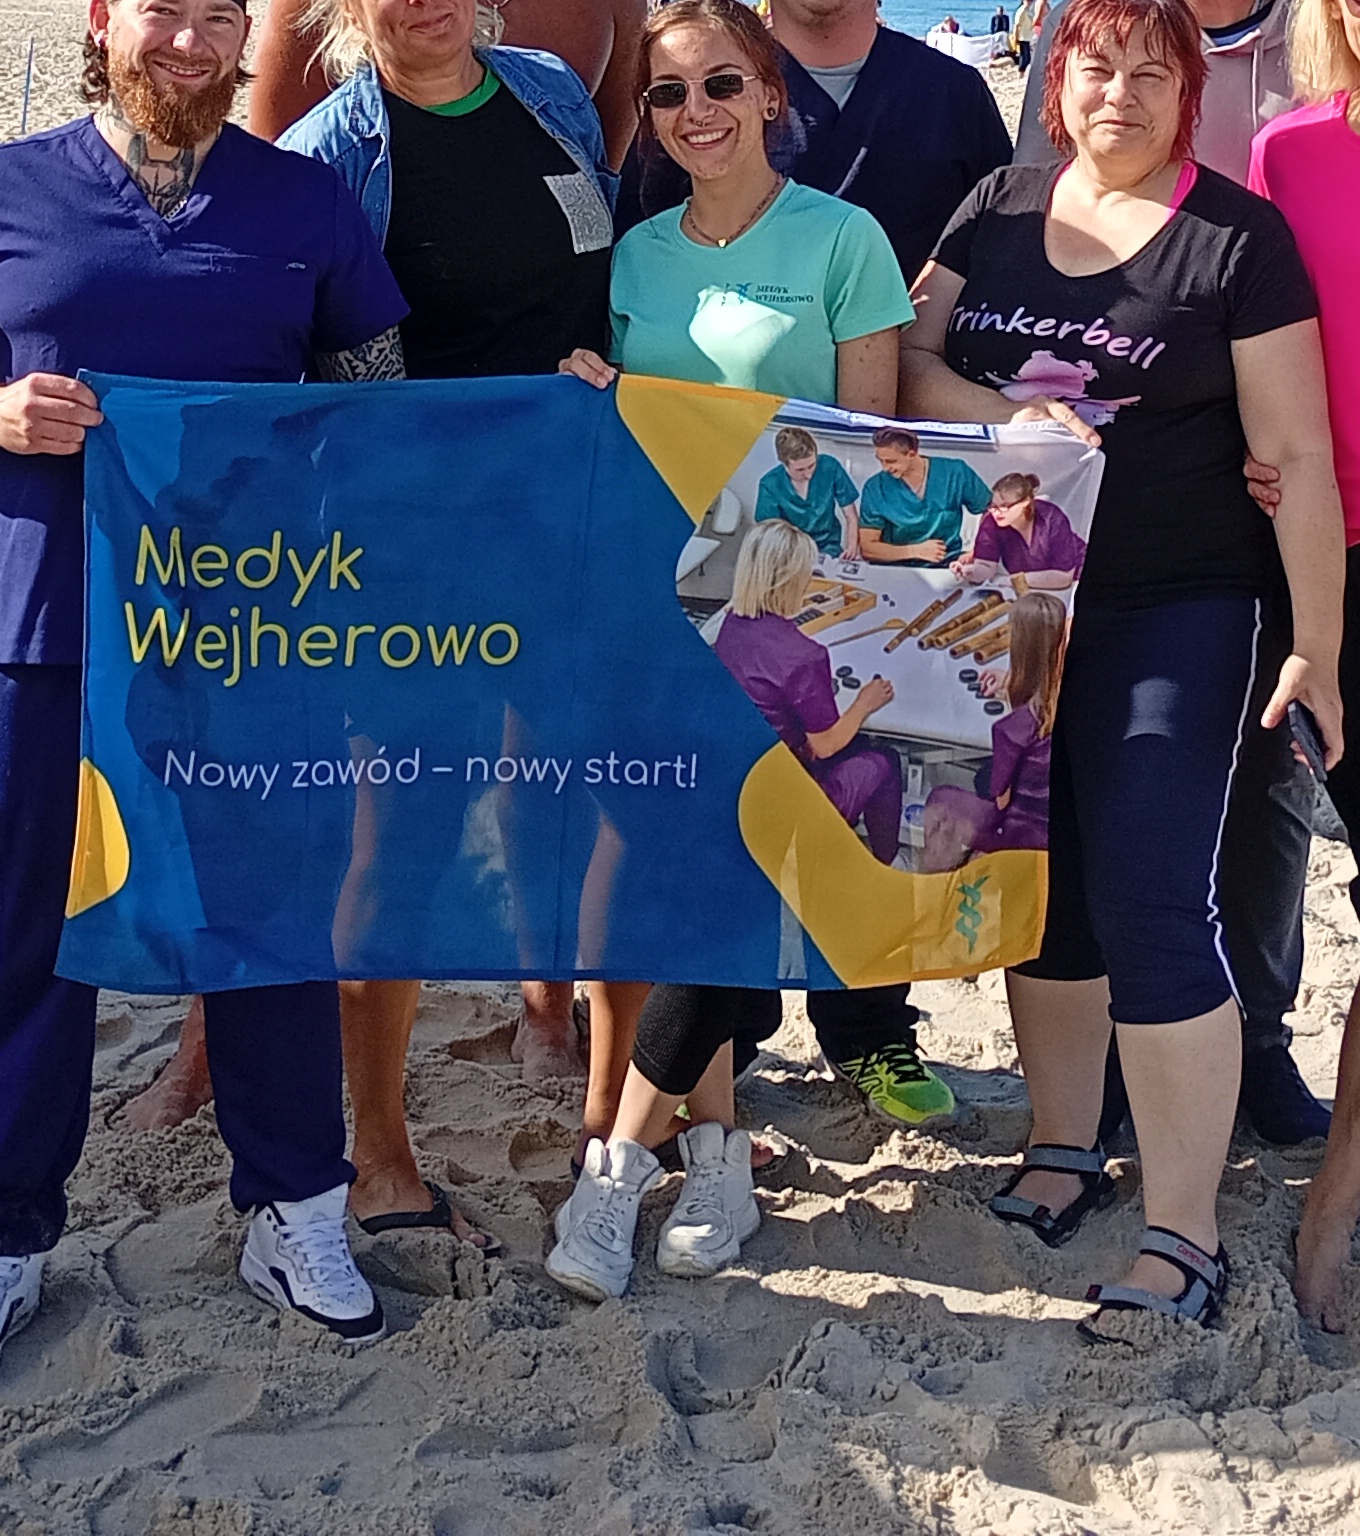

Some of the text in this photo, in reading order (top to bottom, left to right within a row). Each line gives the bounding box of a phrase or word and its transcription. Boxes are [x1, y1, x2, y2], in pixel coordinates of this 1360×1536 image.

[134, 523, 364, 608] Medyk
[124, 601, 520, 688] Wejherowo
[163, 749, 280, 801] Nowy
[292, 745, 421, 789] zawód
[466, 755, 573, 795] nowy
[583, 749, 699, 789] start!
